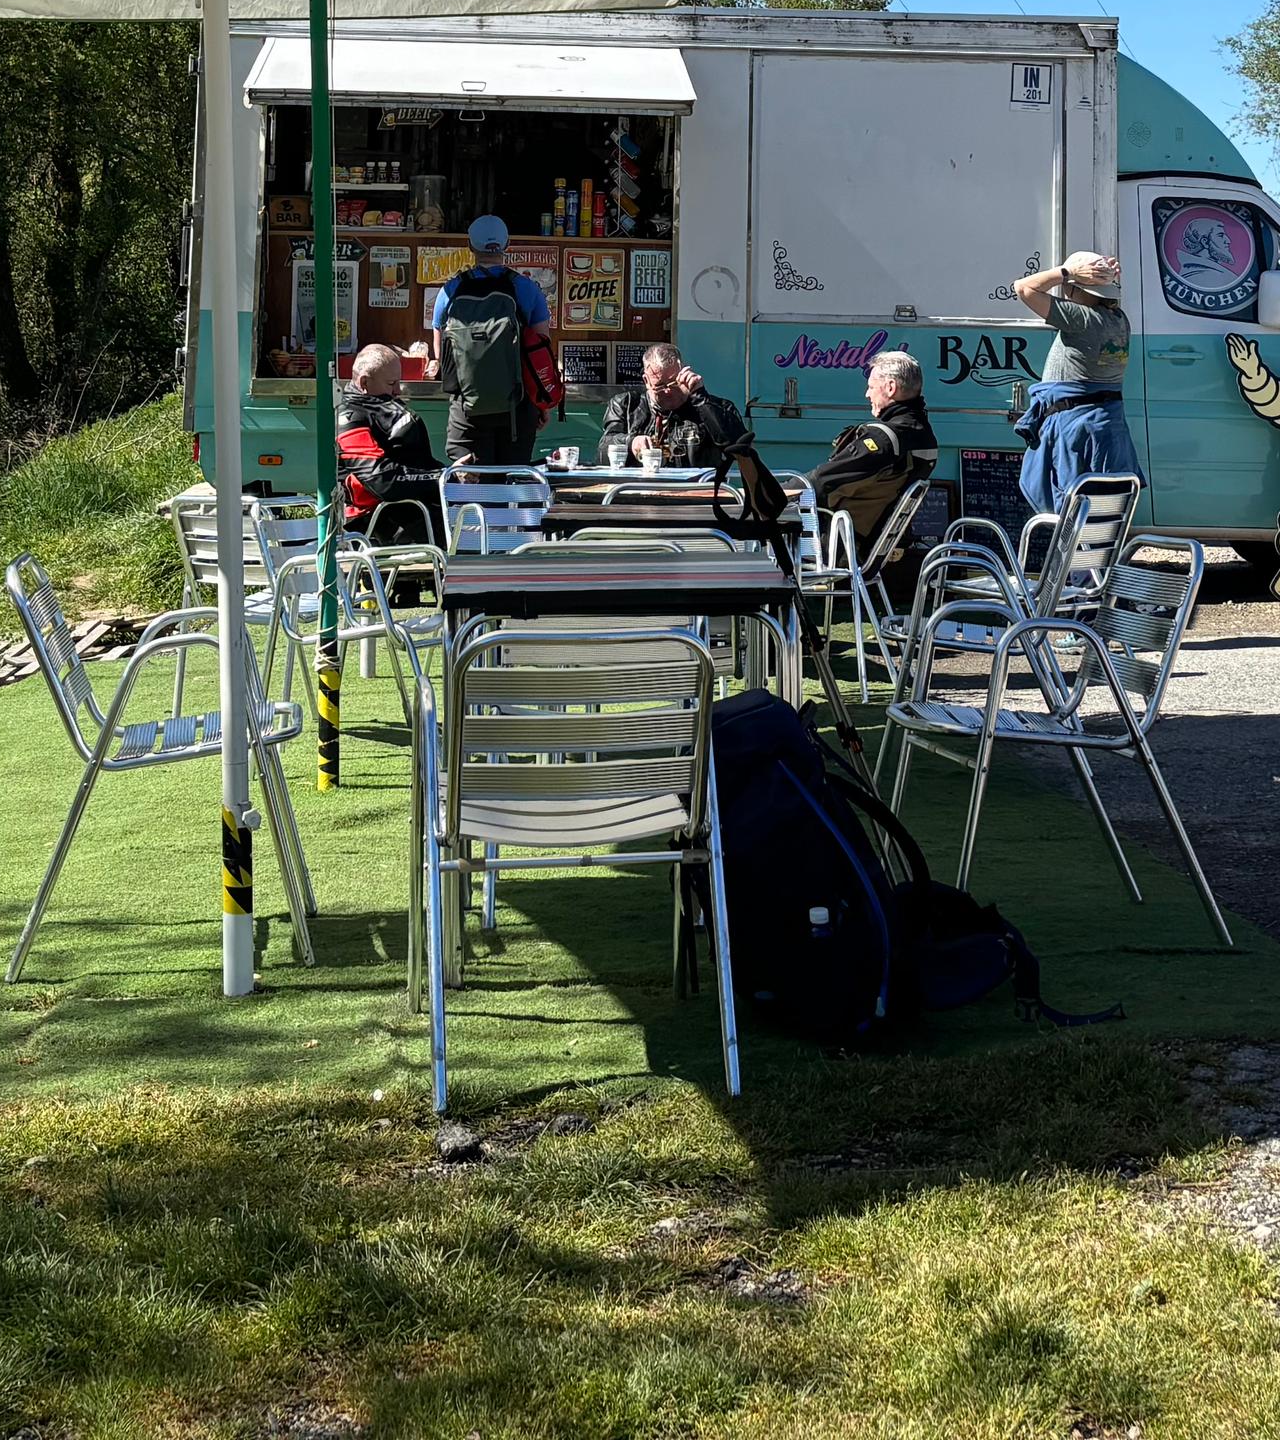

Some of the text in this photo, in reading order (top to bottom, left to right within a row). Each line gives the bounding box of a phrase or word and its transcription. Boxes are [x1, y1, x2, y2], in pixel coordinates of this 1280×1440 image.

[1024, 67, 1040, 88] IN
[398, 108, 432, 119] BEER
[276, 212, 302, 223] BAR
[503, 251, 557, 266] FRESH EGGS
[635, 254, 657, 267] COLD
[635, 268, 666, 286] BEER
[568, 279, 618, 301] COFFEE
[1163, 274, 1258, 307] MÜNCHEN
[937, 334, 1041, 385] BAR
